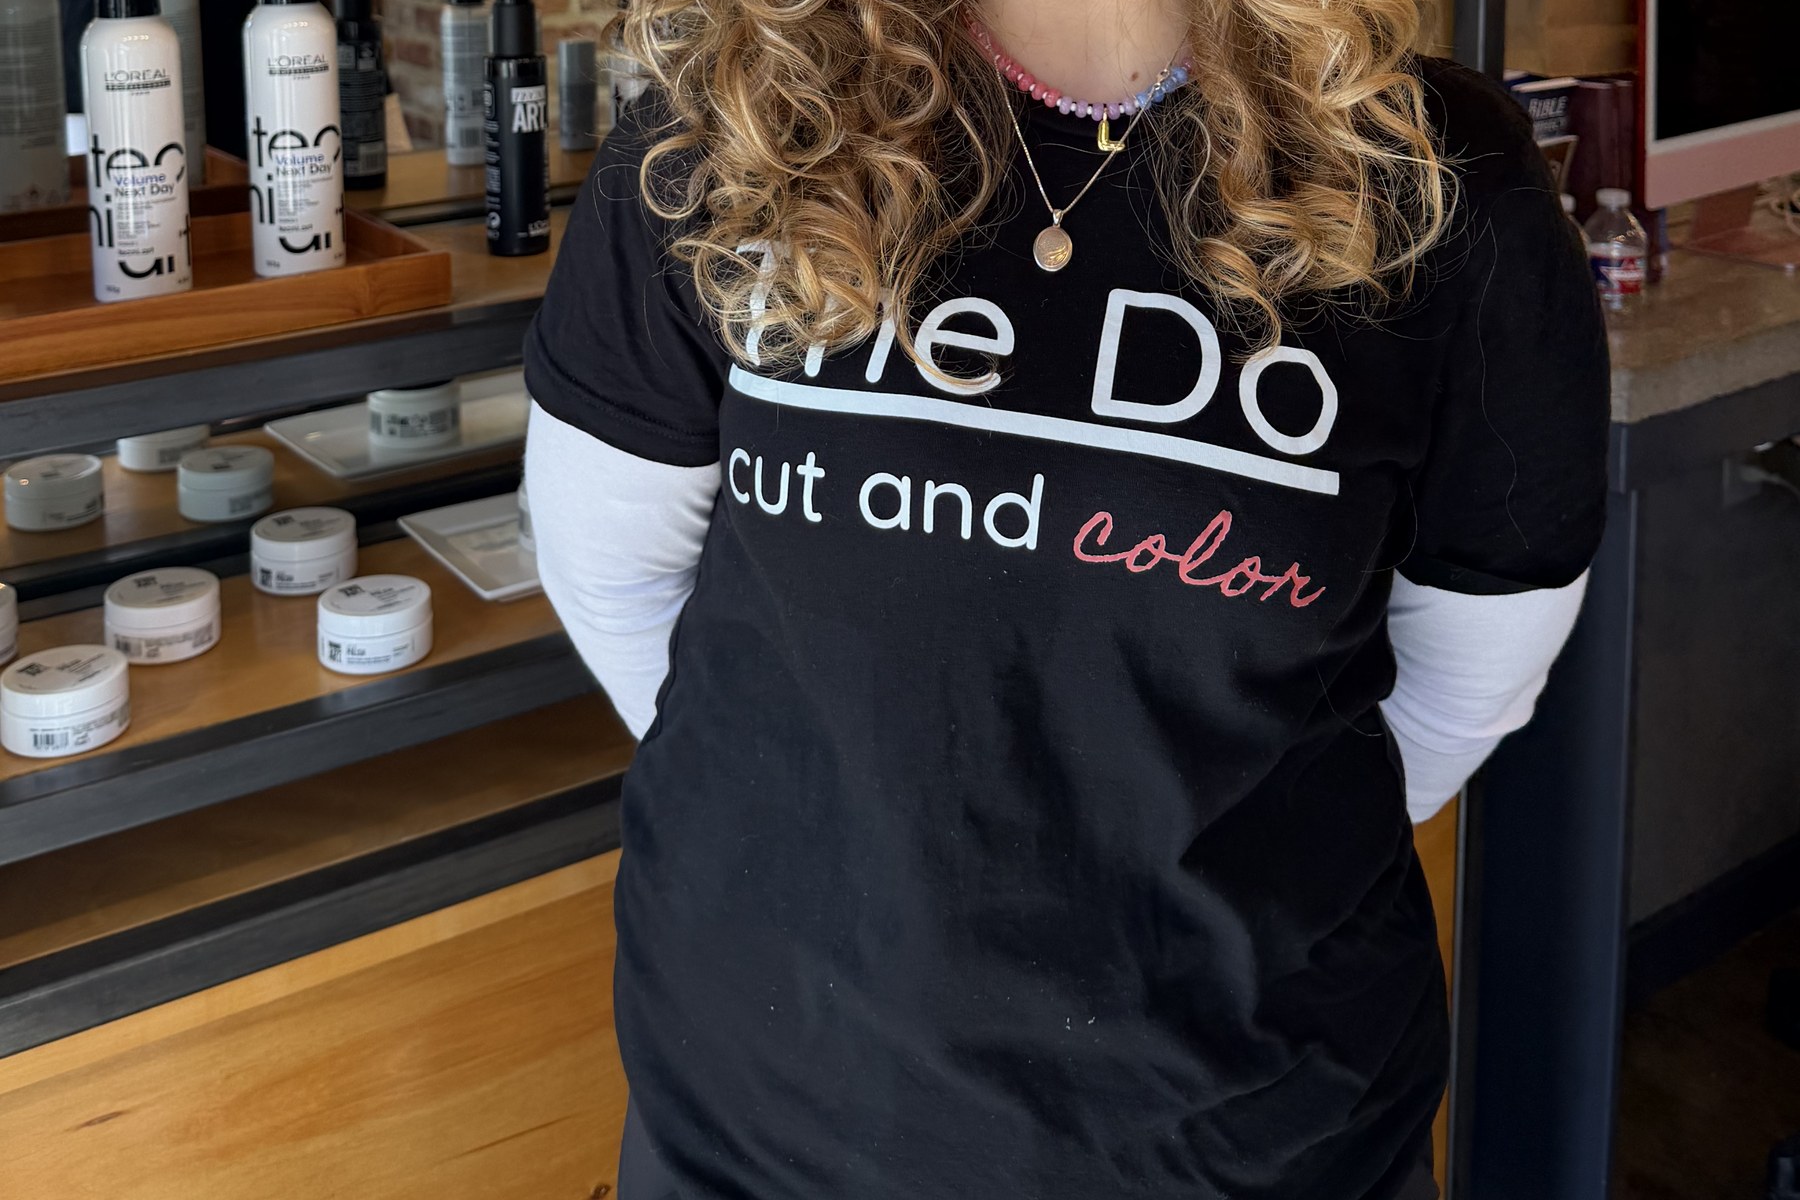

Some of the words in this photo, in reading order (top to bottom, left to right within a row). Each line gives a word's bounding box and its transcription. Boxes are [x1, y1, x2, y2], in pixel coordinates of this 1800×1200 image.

[309, 162, 332, 174] Day
[113, 173, 166, 187] Volume
[150, 183, 175, 196] Day
[1091, 288, 1339, 455] Do
[728, 447, 826, 523] cut
[858, 472, 1045, 551] and
[1072, 509, 1327, 608] color
